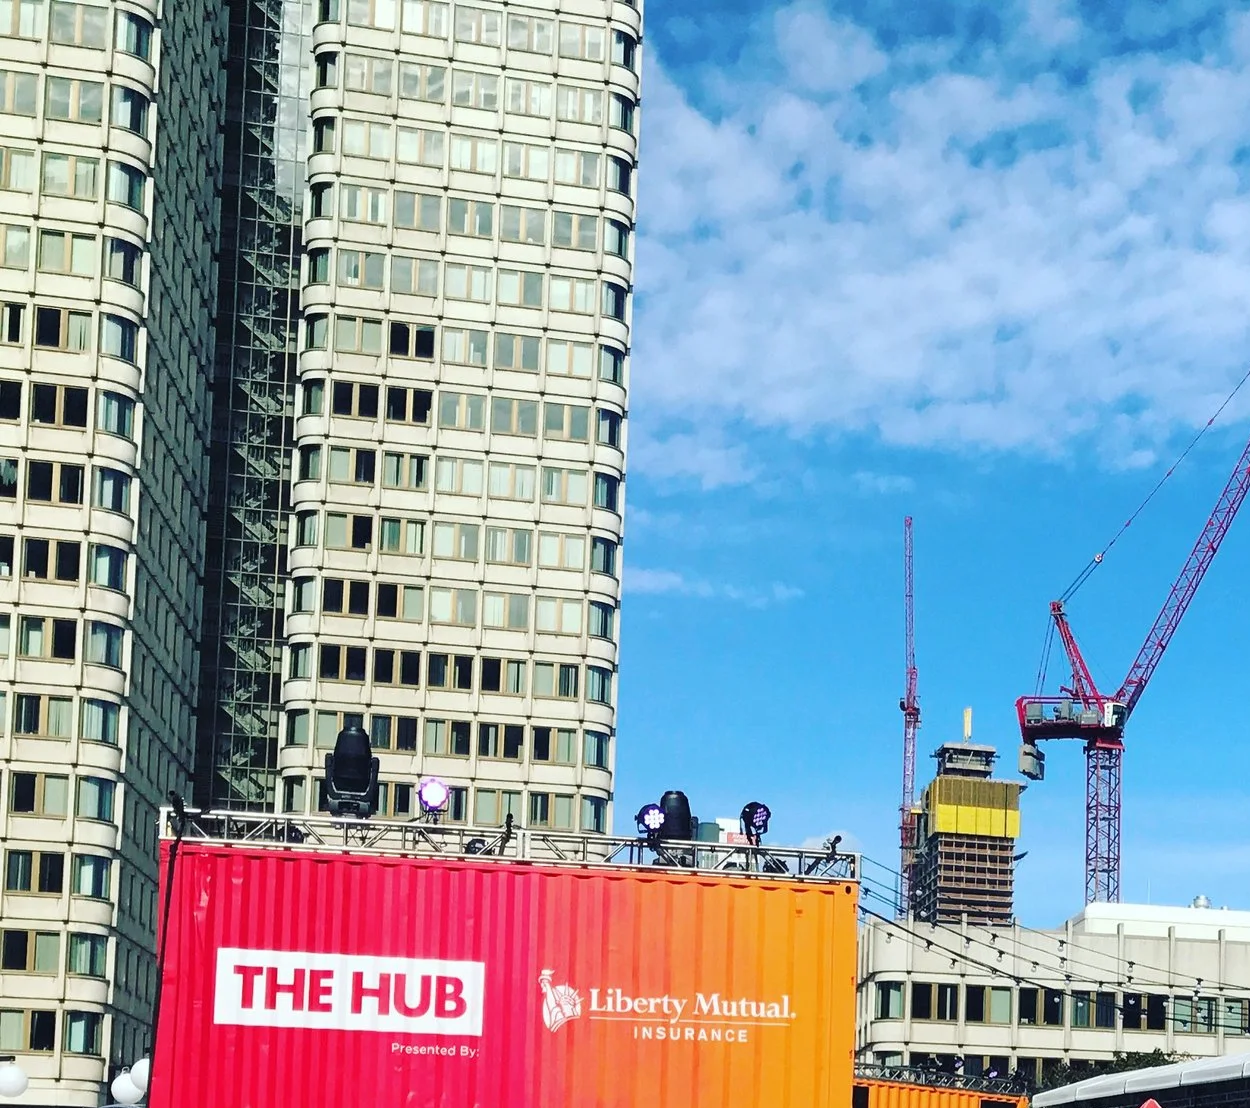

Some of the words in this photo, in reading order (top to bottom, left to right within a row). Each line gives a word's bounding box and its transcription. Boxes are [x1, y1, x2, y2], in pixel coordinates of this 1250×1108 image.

[233, 964, 333, 1013] THE
[351, 971, 467, 1019] HUB
[589, 988, 688, 1024] Liberty
[633, 1026, 747, 1042] INSURANCE
[391, 1042, 456, 1056] Presented
[460, 1046, 480, 1058] By:
